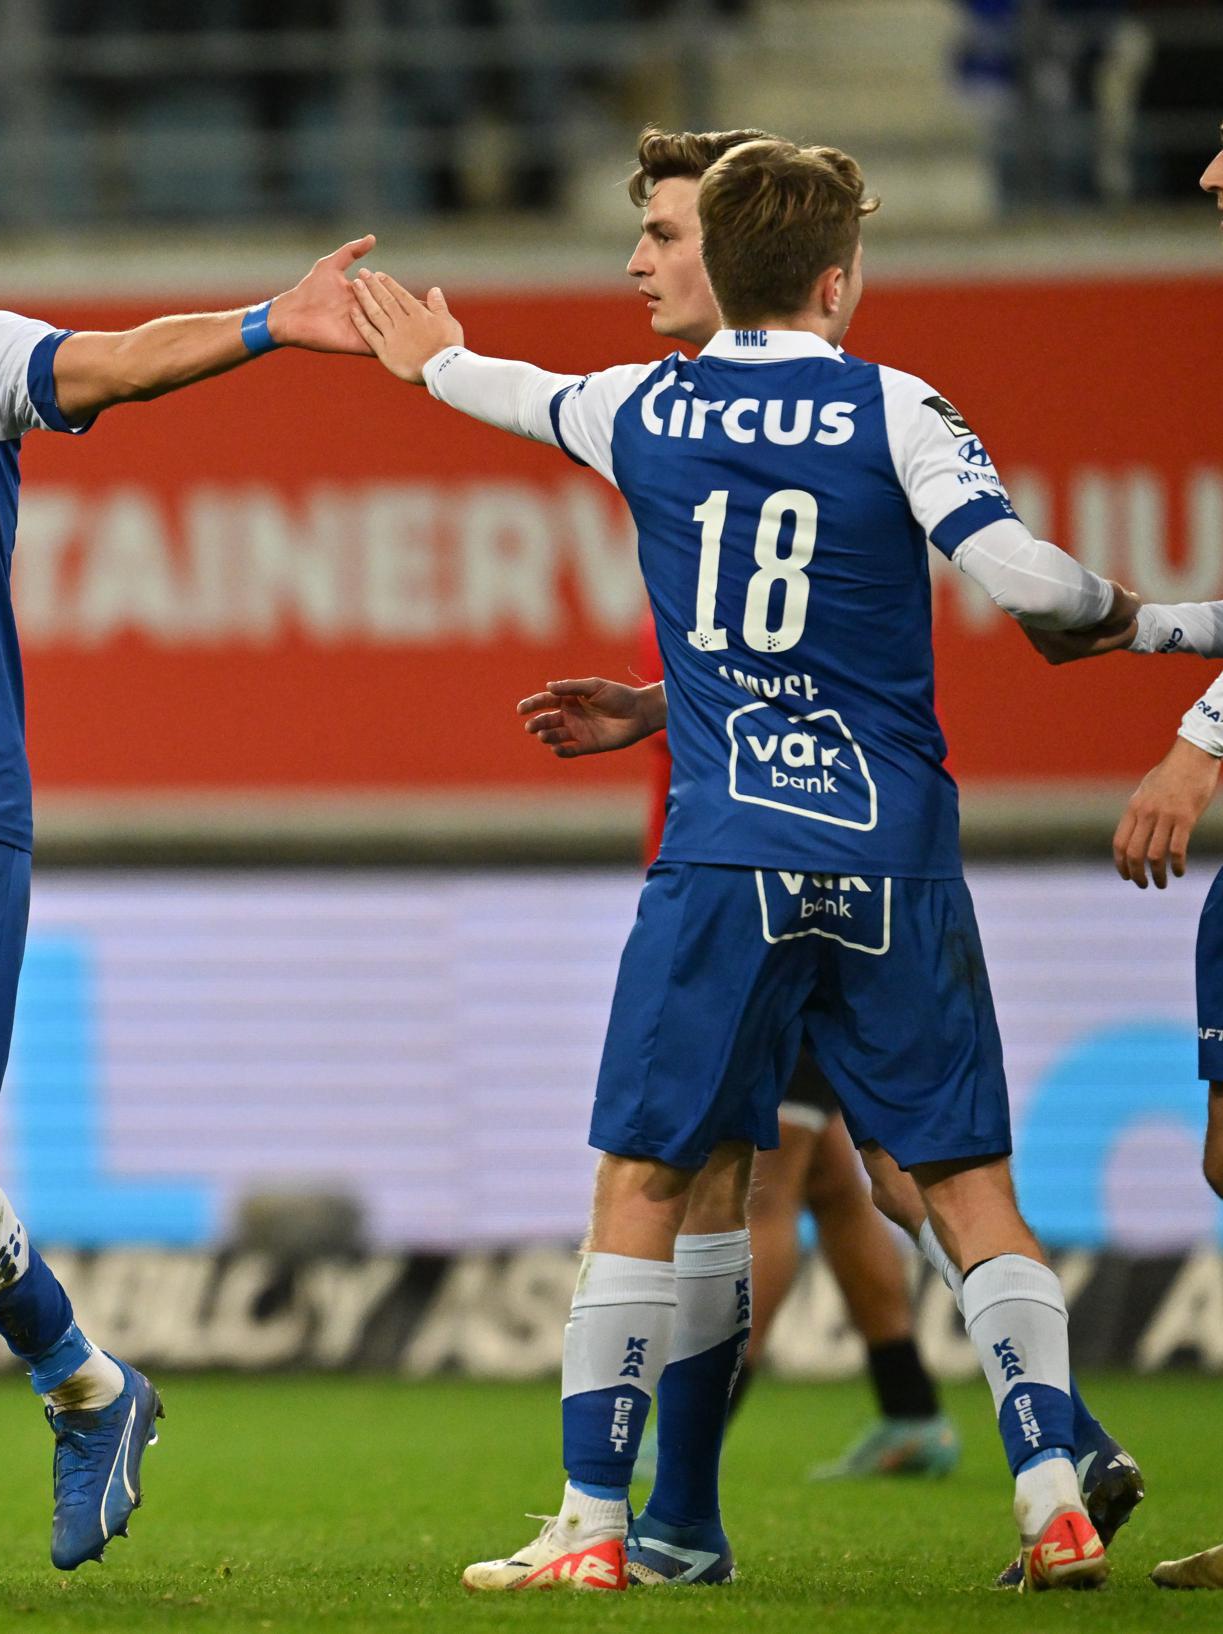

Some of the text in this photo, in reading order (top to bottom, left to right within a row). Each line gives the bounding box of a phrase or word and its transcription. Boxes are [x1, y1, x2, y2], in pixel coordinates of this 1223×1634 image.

[641, 370, 857, 446] Circus
[687, 489, 819, 653] 18
[771, 766, 838, 793] bank
[734, 1277, 751, 1324] KAA
[619, 1337, 649, 1378] KAA
[992, 1337, 1025, 1382] KAA
[610, 1397, 633, 1453] GENT
[1014, 1393, 1042, 1449] GENT
